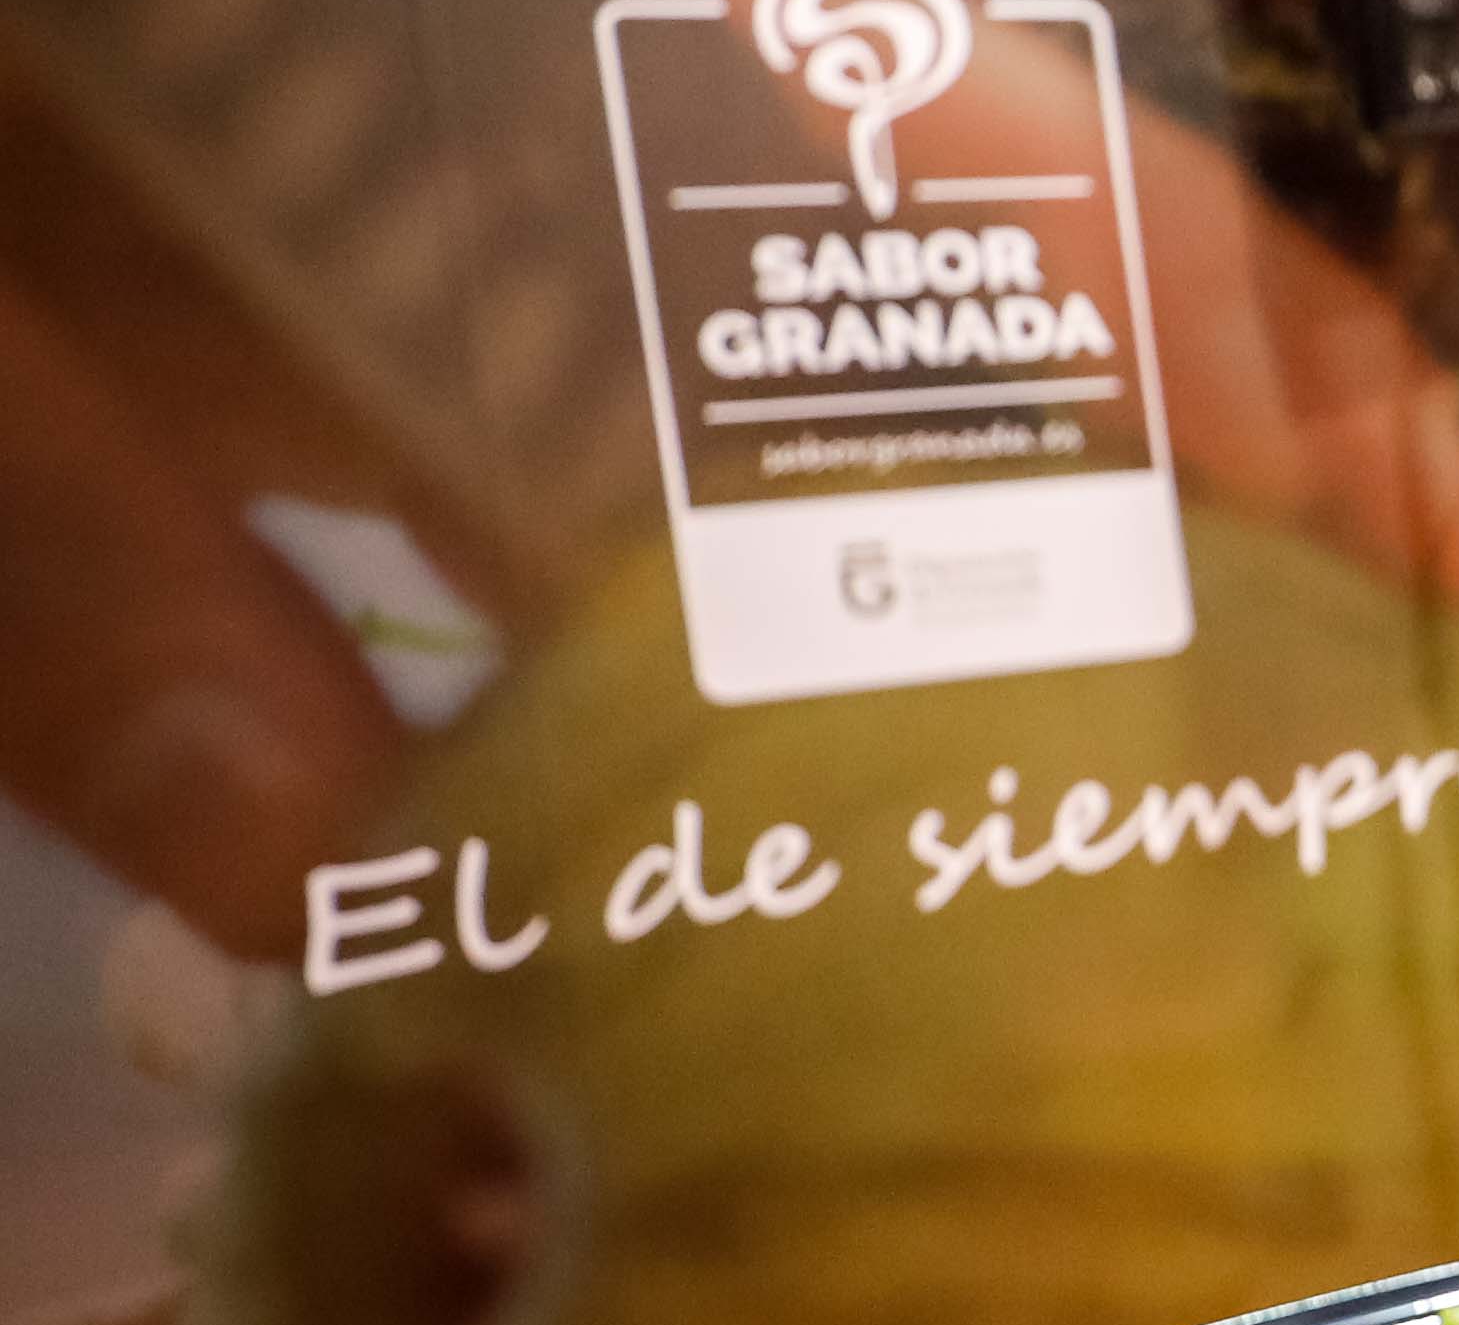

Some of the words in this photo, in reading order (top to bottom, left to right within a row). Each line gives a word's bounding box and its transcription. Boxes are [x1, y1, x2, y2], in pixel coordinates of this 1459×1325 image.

[751, 225, 1042, 304] SABOR
[696, 290, 1116, 380] GRANADA
[302, 837, 548, 996] El
[604, 799, 843, 943] de
